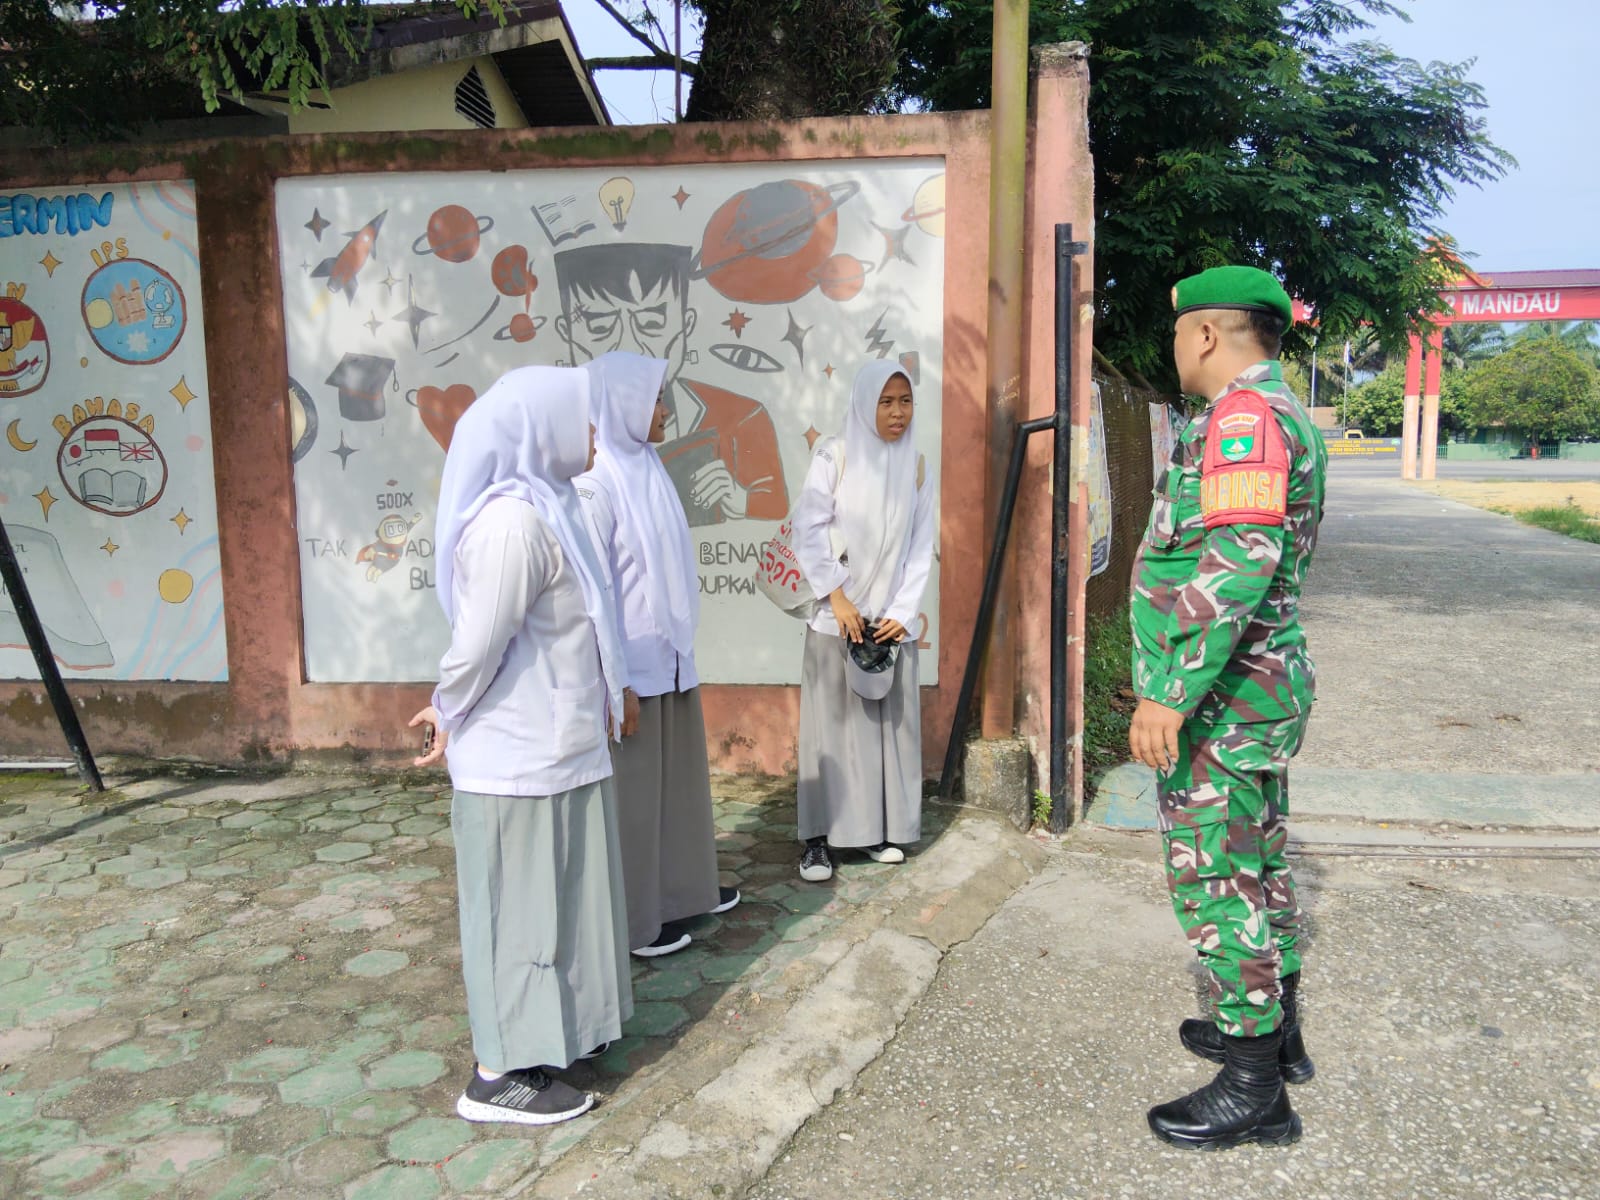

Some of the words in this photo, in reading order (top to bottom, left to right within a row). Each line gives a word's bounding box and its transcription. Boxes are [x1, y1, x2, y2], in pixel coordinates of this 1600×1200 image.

[90, 237, 129, 267] IPS
[1462, 291, 1560, 315] MANDAU
[52, 396, 155, 438] BAHASA
[305, 538, 347, 558] TAK
[405, 538, 435, 558] AD
